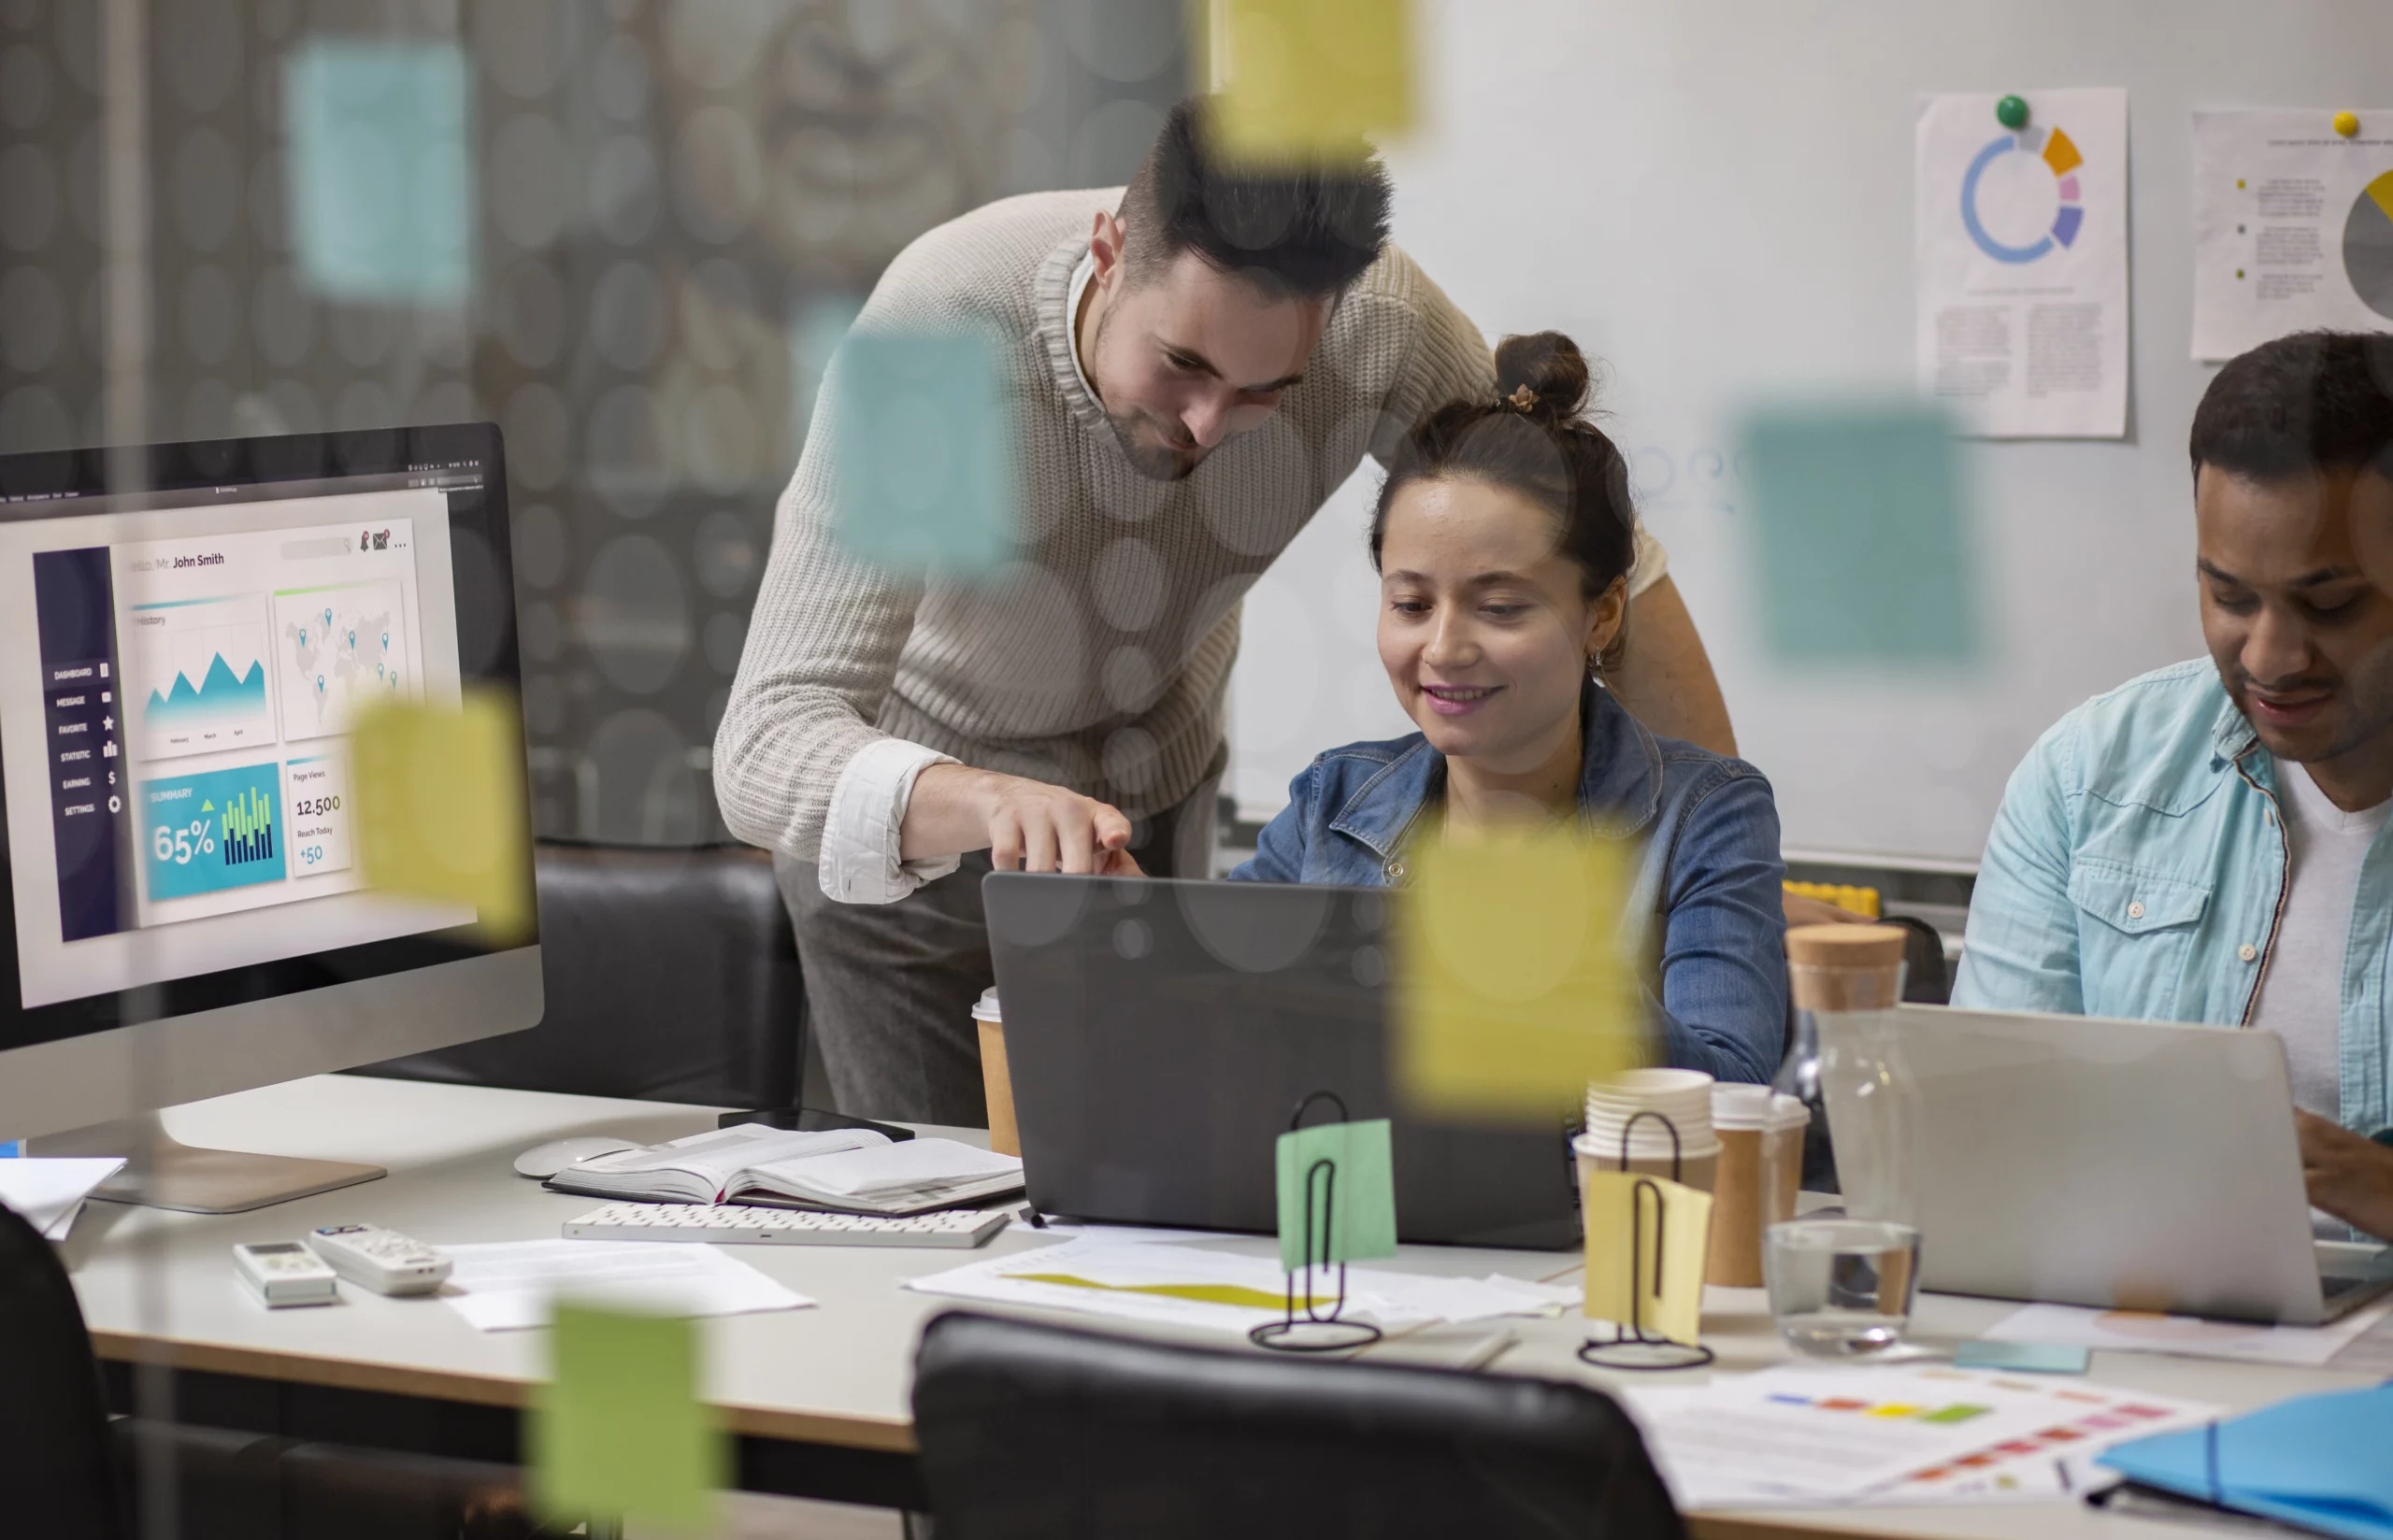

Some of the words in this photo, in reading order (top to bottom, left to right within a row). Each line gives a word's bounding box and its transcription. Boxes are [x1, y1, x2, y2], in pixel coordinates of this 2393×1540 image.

[173, 555, 195, 569] John
[197, 552, 224, 566] Smith
[54, 667, 93, 680] DASHBOARD
[56, 695, 86, 707] MESSAGE
[58, 722, 88, 734] FAVORITE
[293, 773, 308, 783] Page
[308, 770, 325, 779] Views
[150, 788, 193, 803] SUMMARY
[64, 804, 95, 817] SETTINGS
[296, 795, 340, 816] 12.500
[297, 828, 315, 838] Reach
[316, 826, 333, 836] Today
[154, 819, 215, 864] 65%
[300, 845, 323, 864] +50
